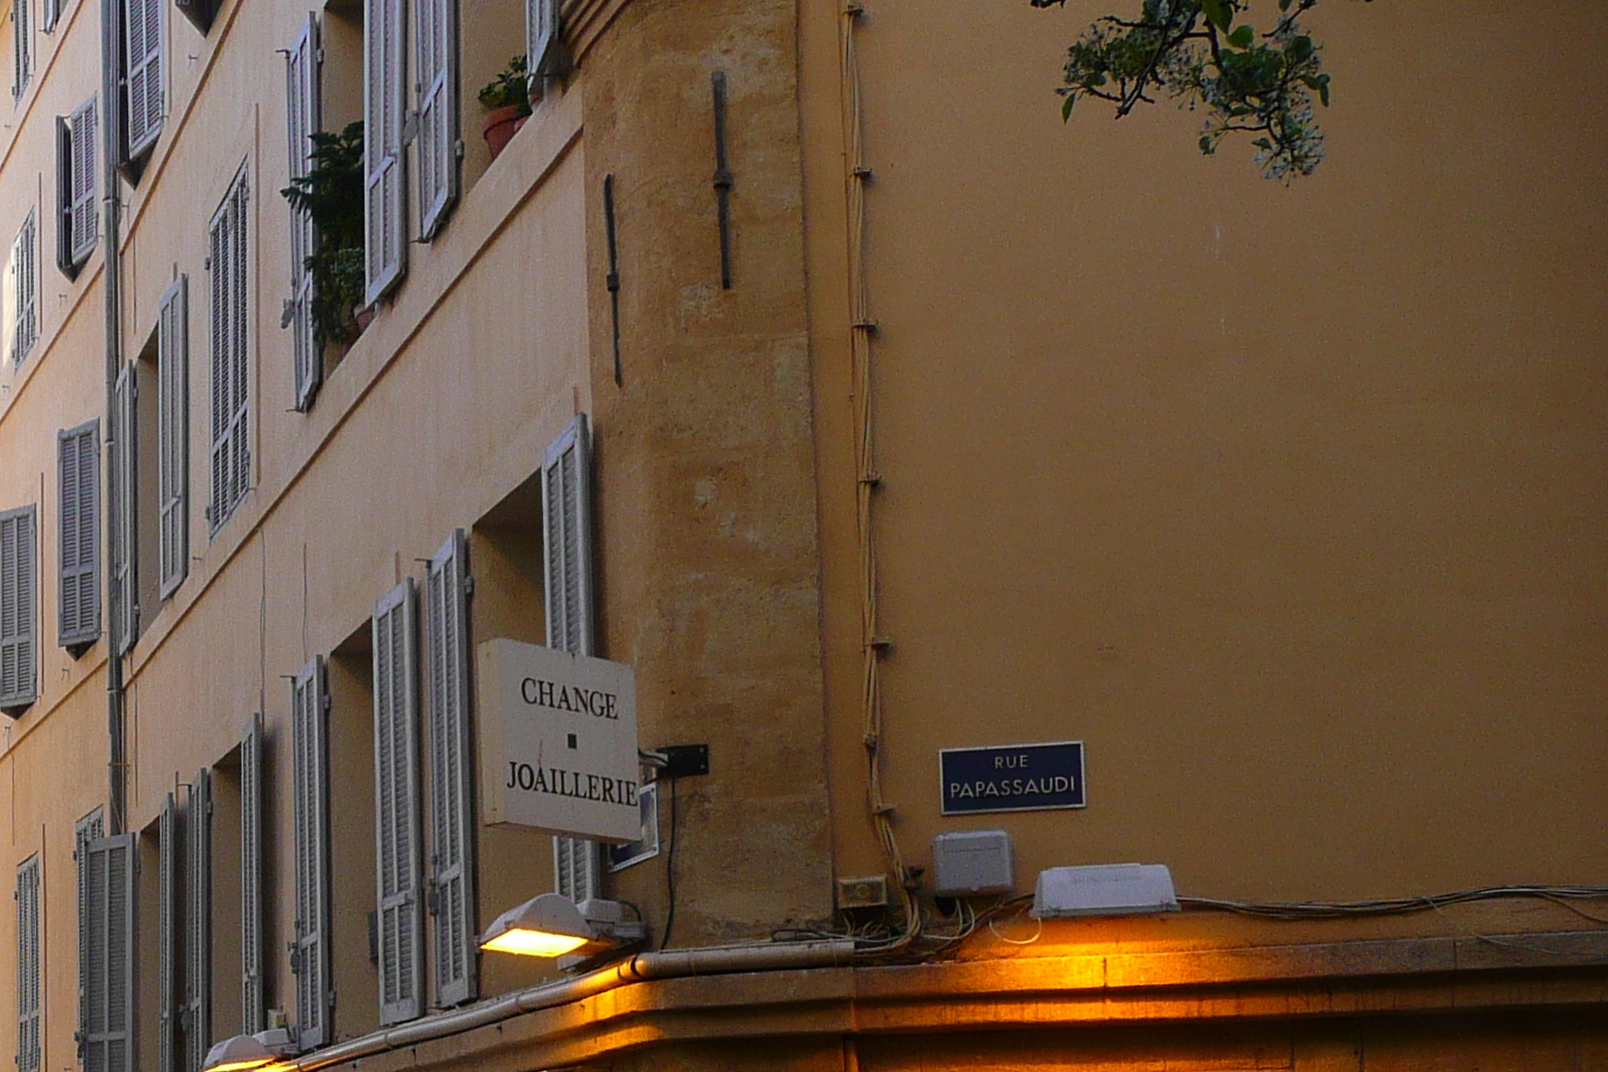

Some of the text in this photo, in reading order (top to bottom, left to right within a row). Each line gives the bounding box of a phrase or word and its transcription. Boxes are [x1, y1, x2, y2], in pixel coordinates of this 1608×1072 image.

[520, 676, 619, 720] CHANGE
[994, 754, 1029, 770] RUE
[506, 760, 639, 808] JOAILLERIE
[949, 775, 1076, 799] PAPASSAUDI
